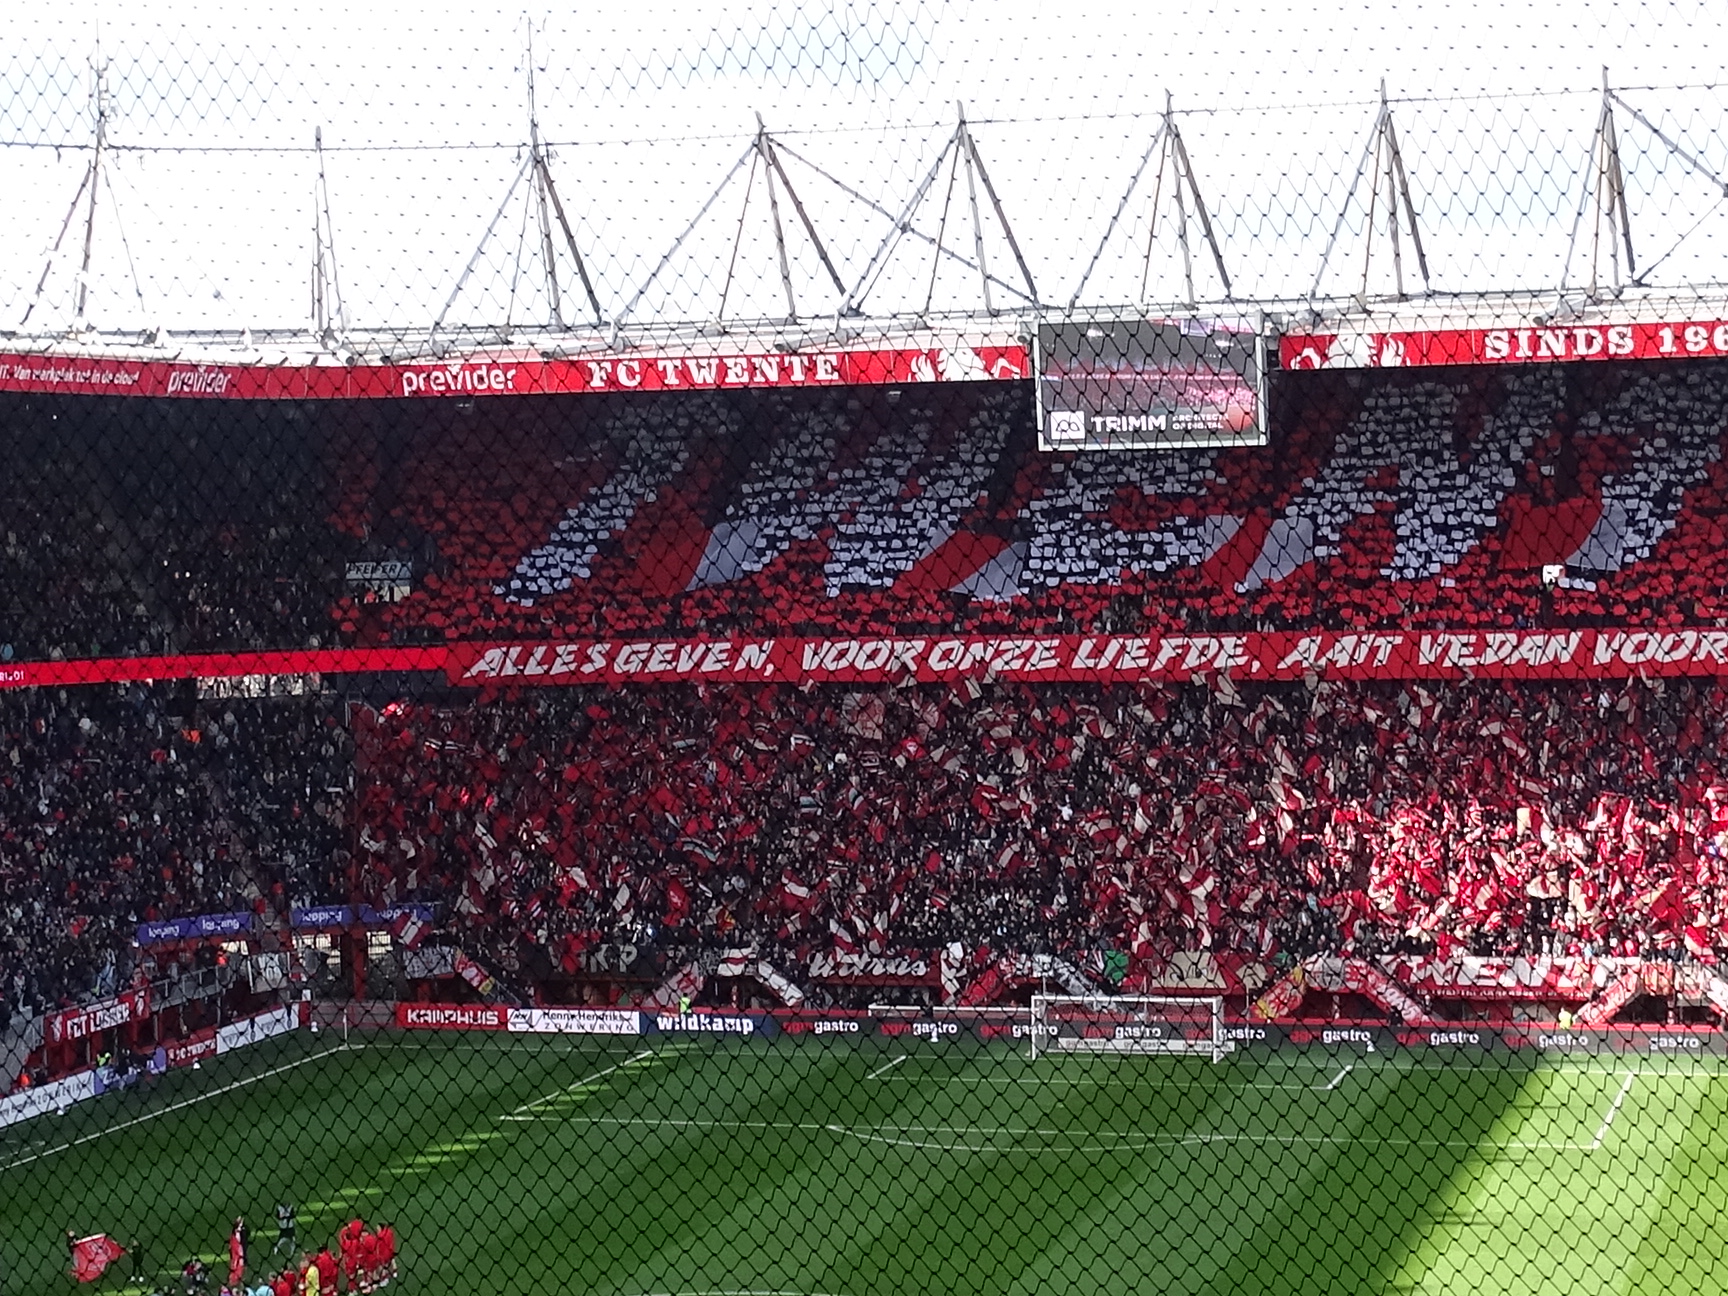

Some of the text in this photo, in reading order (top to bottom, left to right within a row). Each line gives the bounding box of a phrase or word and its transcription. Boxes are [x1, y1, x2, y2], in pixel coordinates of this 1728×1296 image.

[1483, 326, 1633, 360] SINDS
[168, 364, 232, 393] previder
[402, 361, 514, 396] previder
[589, 353, 842, 388] FC TWENTE
[1090, 415, 1166, 433] TRIMM
[463, 642, 611, 679] ALLES
[613, 640, 775, 676] GEVEN,
[802, 640, 926, 671] VOOR
[928, 636, 1060, 671] ONZE
[407, 1009, 499, 1026] KAMPHUIS
[544, 1023, 634, 1032] ZONWERING
[657, 1014, 754, 1035] wildkamp
